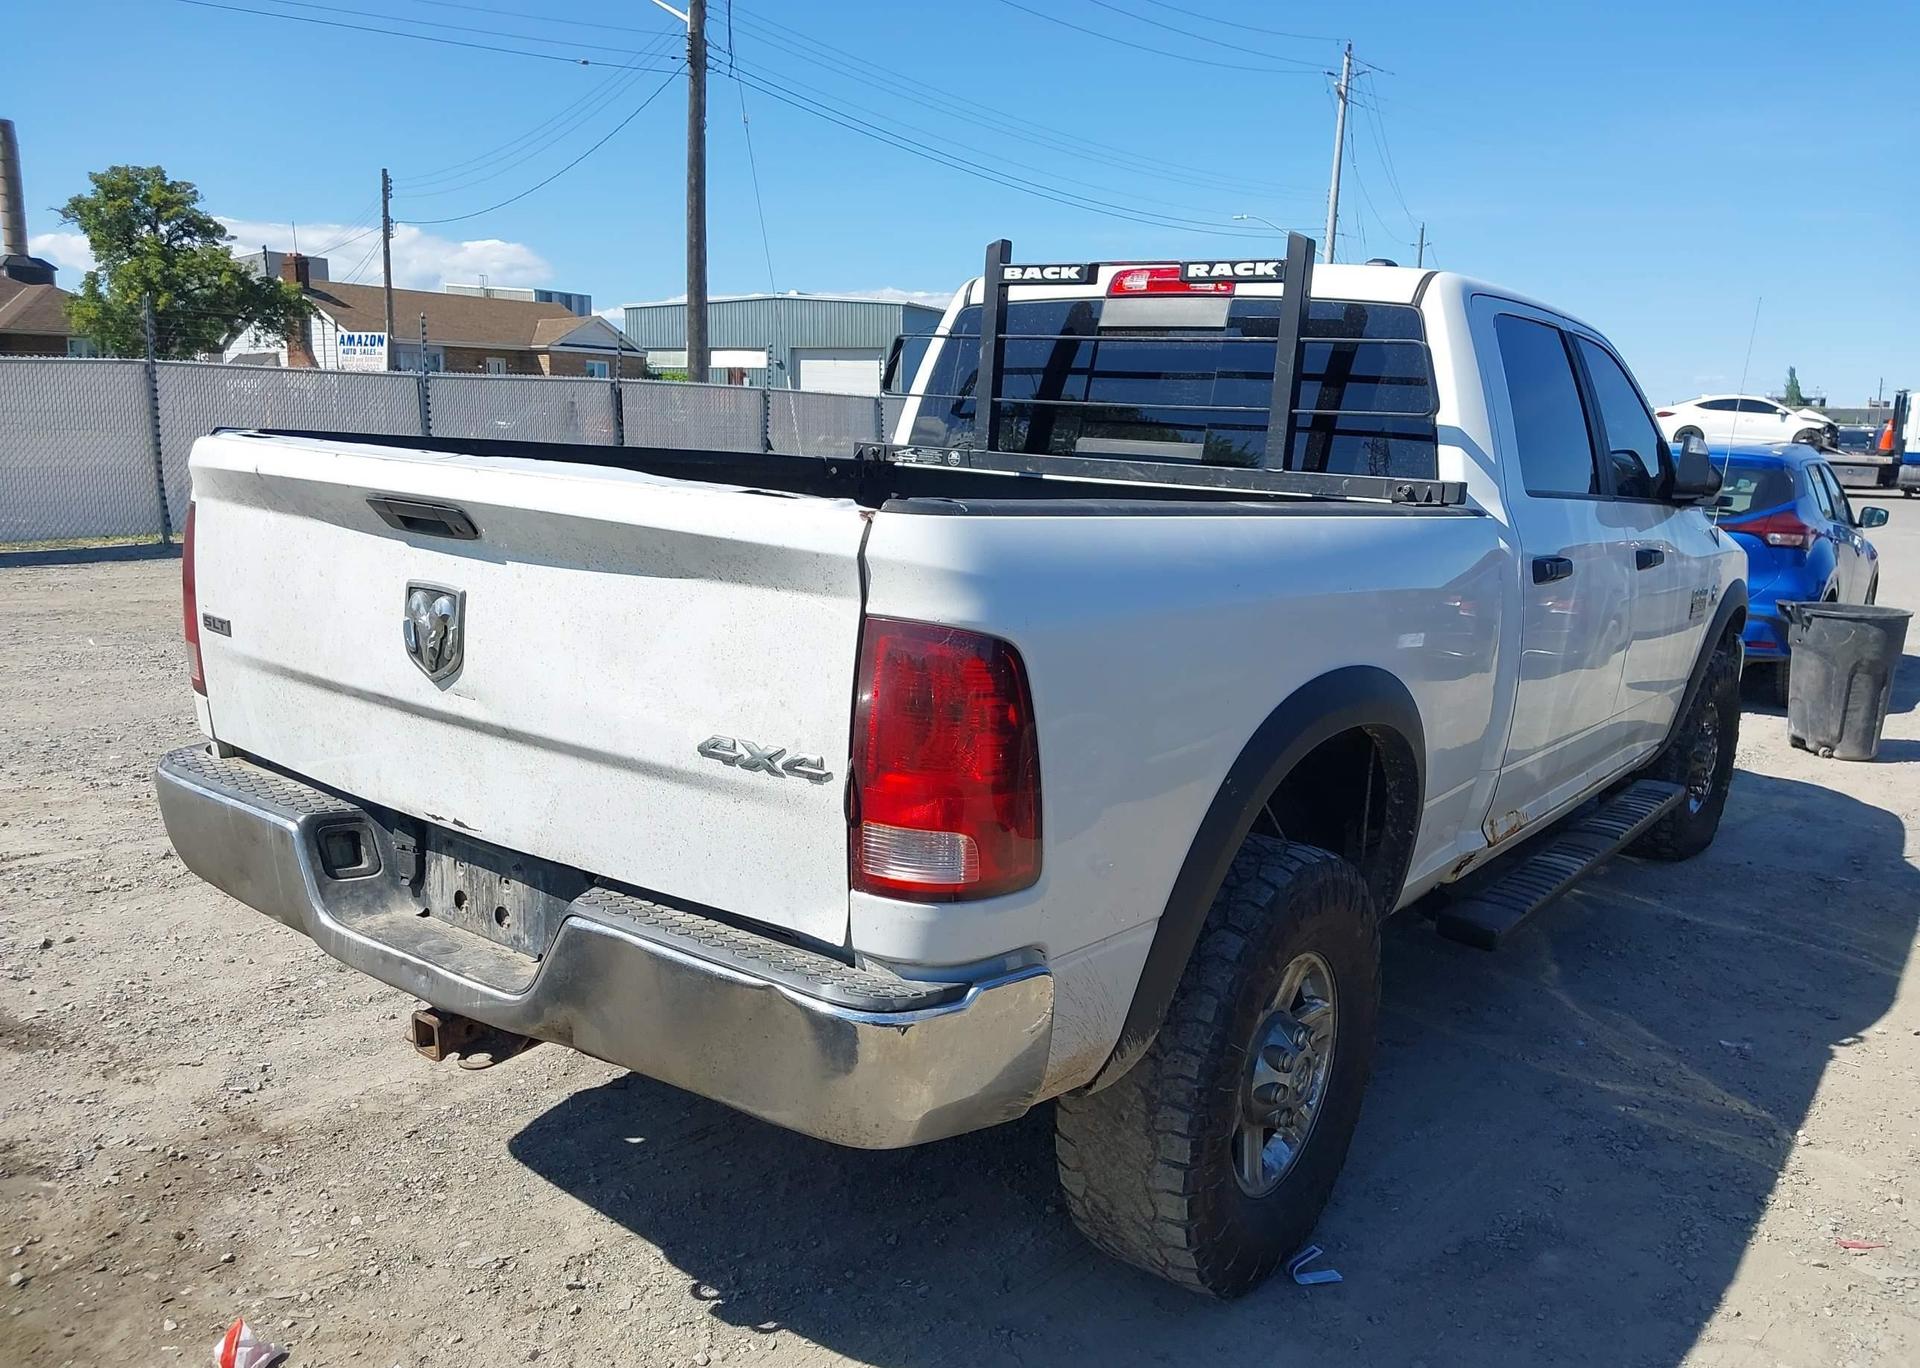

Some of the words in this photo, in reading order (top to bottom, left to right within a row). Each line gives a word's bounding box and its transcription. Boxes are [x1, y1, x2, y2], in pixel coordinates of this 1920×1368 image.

[1003, 266, 1081, 280] BACK
[1187, 262, 1278, 278] RACK
[339, 334, 385, 347] AMAZON
[204, 614, 227, 632] SLT
[697, 734, 834, 785] 4X4
